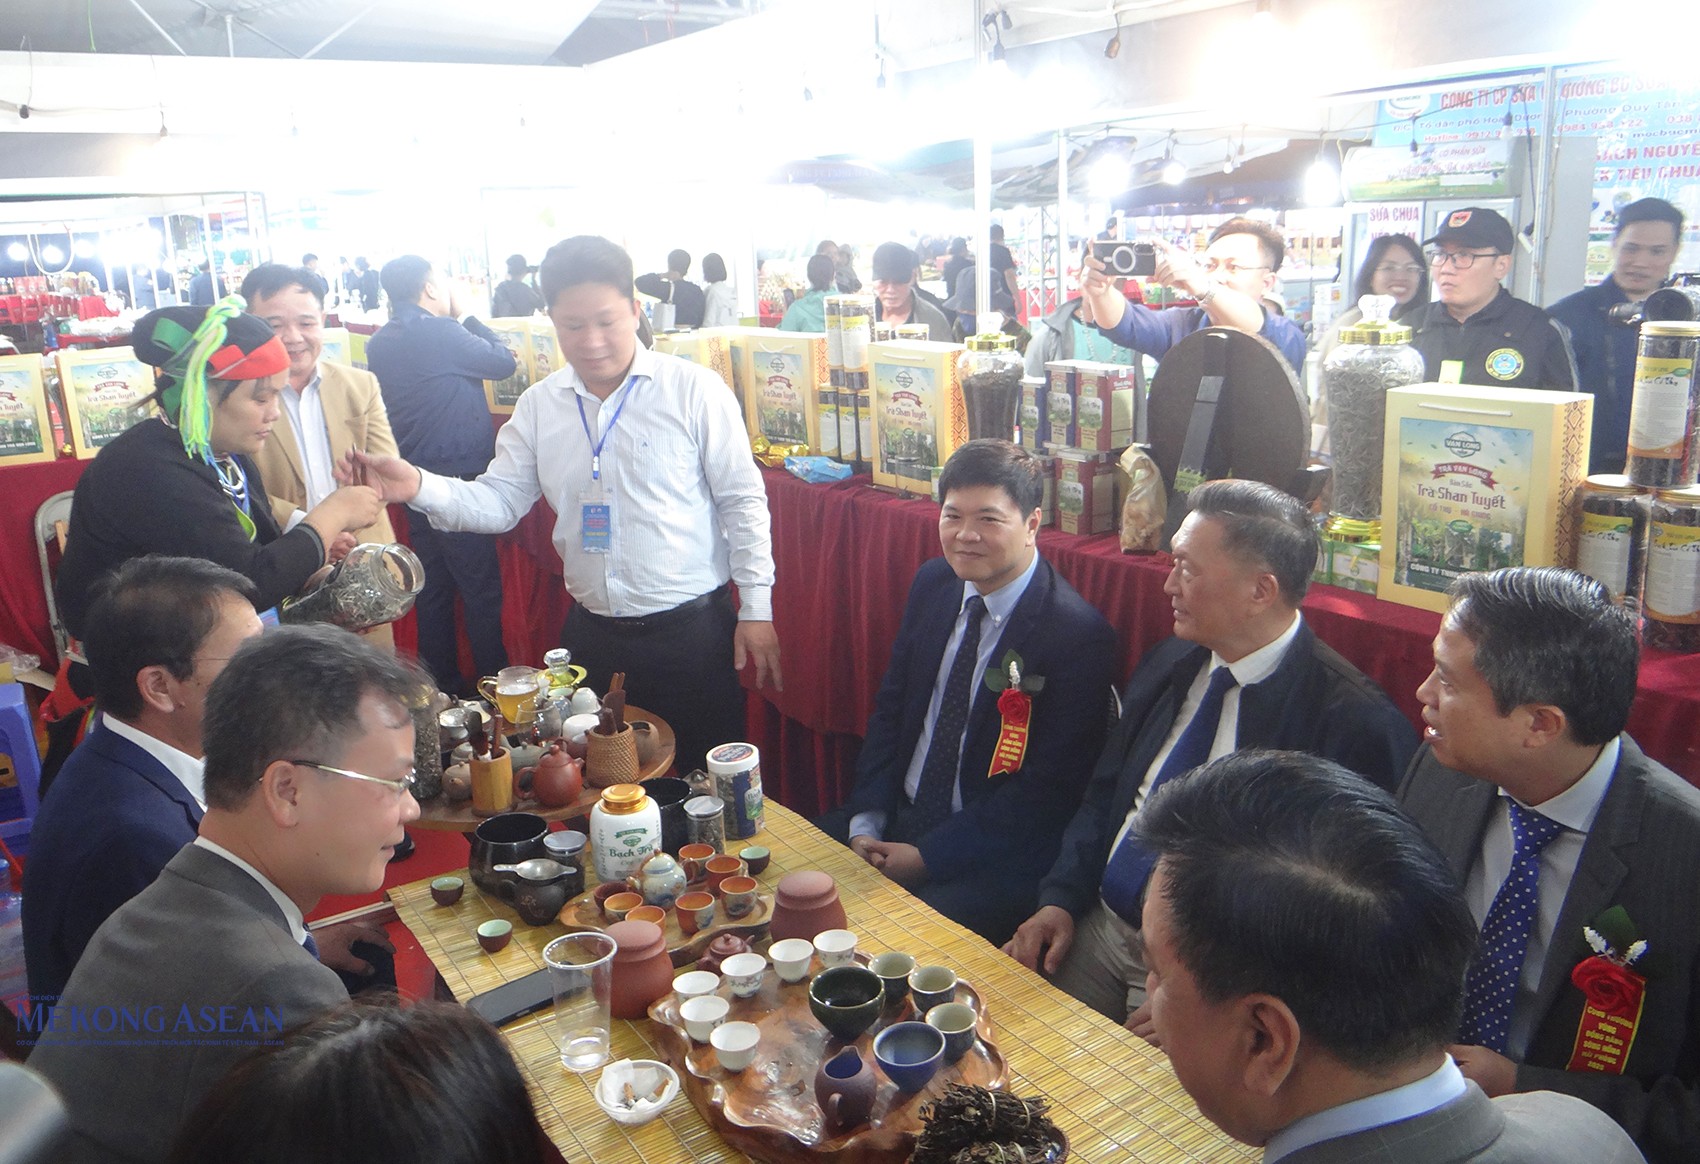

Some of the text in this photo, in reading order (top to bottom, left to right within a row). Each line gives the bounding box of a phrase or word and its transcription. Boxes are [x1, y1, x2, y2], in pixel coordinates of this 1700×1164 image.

[1417, 483, 1507, 511] Trà Shan Tuyết
